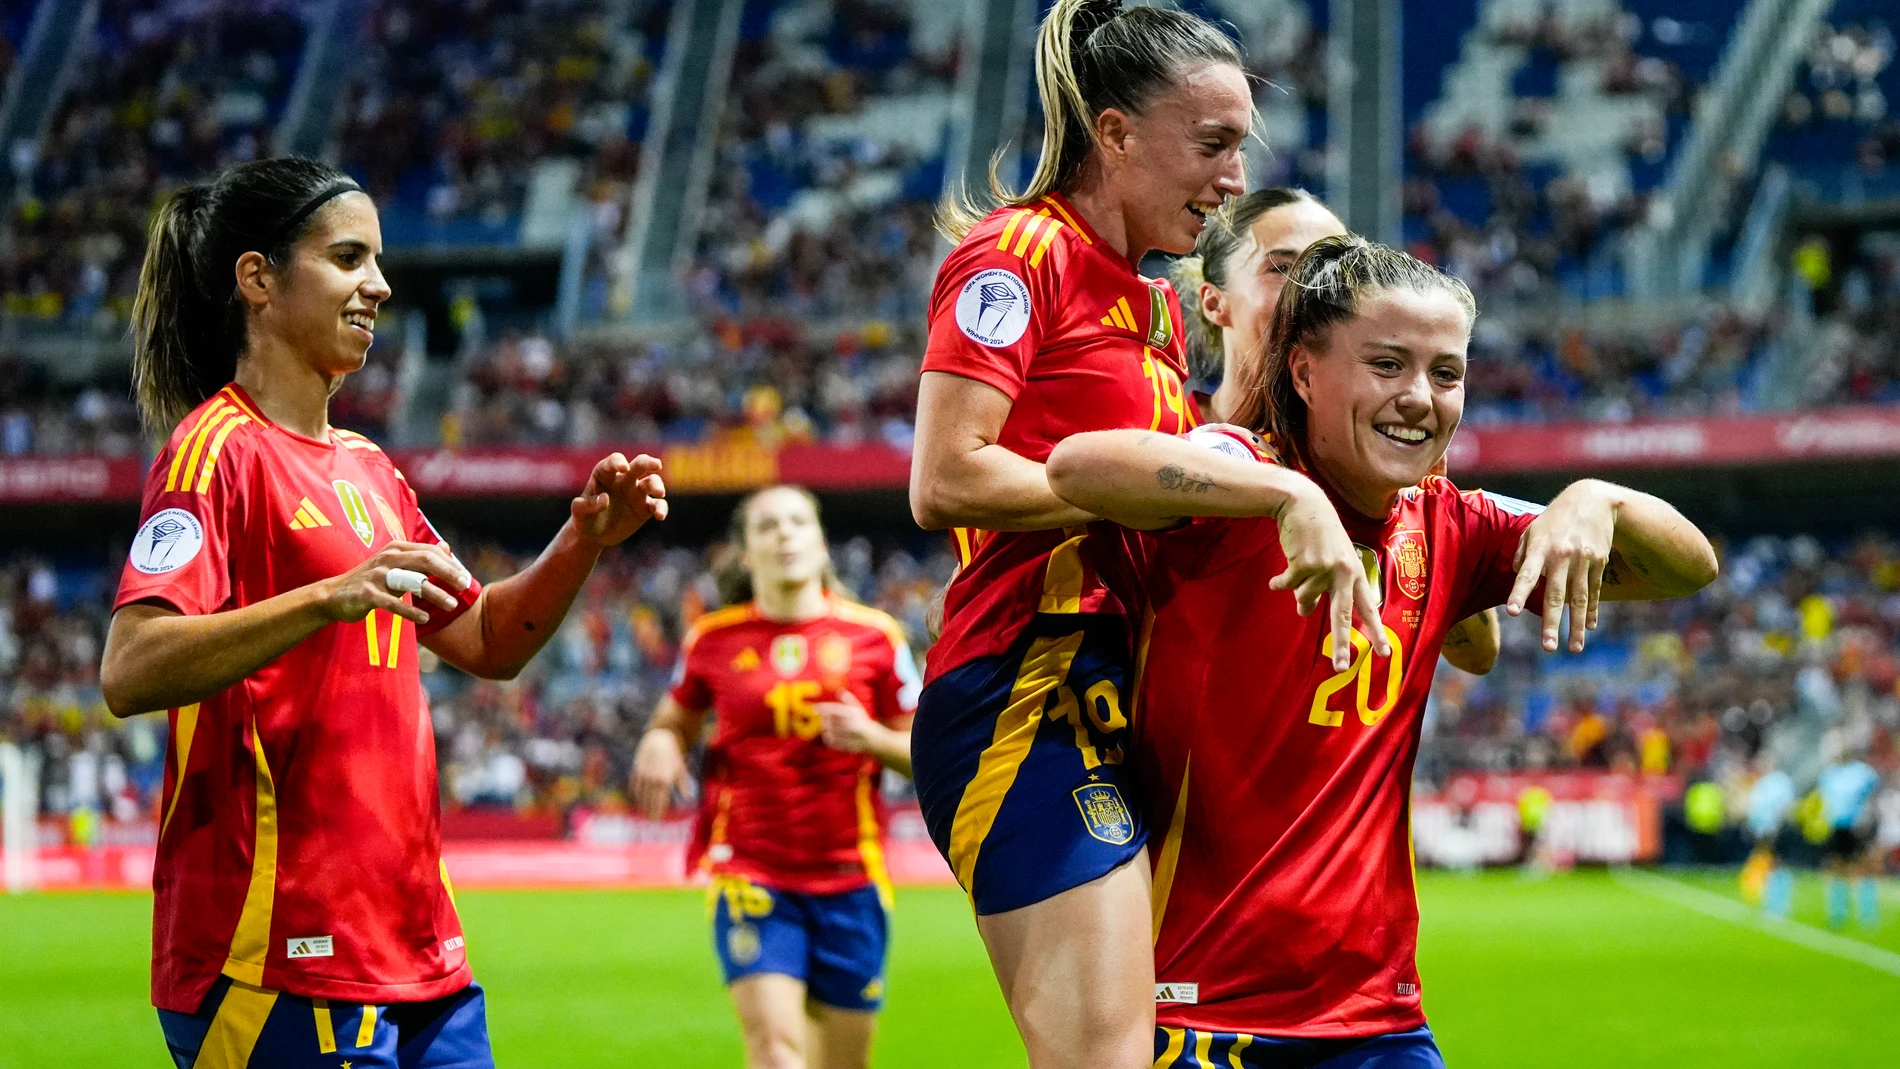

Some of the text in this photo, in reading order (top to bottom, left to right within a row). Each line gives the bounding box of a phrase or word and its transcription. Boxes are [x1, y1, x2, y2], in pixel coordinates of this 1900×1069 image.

[964, 281, 976, 293] UEFA
[975, 271, 1002, 281] WOMEN'S
[1003, 273, 1024, 292] NATIONS
[966, 326, 988, 343] WINNER
[1153, 330, 1166, 342] FIFA
[1142, 346, 1183, 434] 19
[139, 525, 149, 537] UEFA
[172, 511, 193, 523] NATIONS
[190, 521, 200, 540] LEAGUE
[139, 564, 158, 572] WINNER
[1308, 624, 1402, 727] 20
[765, 680, 823, 740] 15
[1047, 679, 1128, 770] 19
